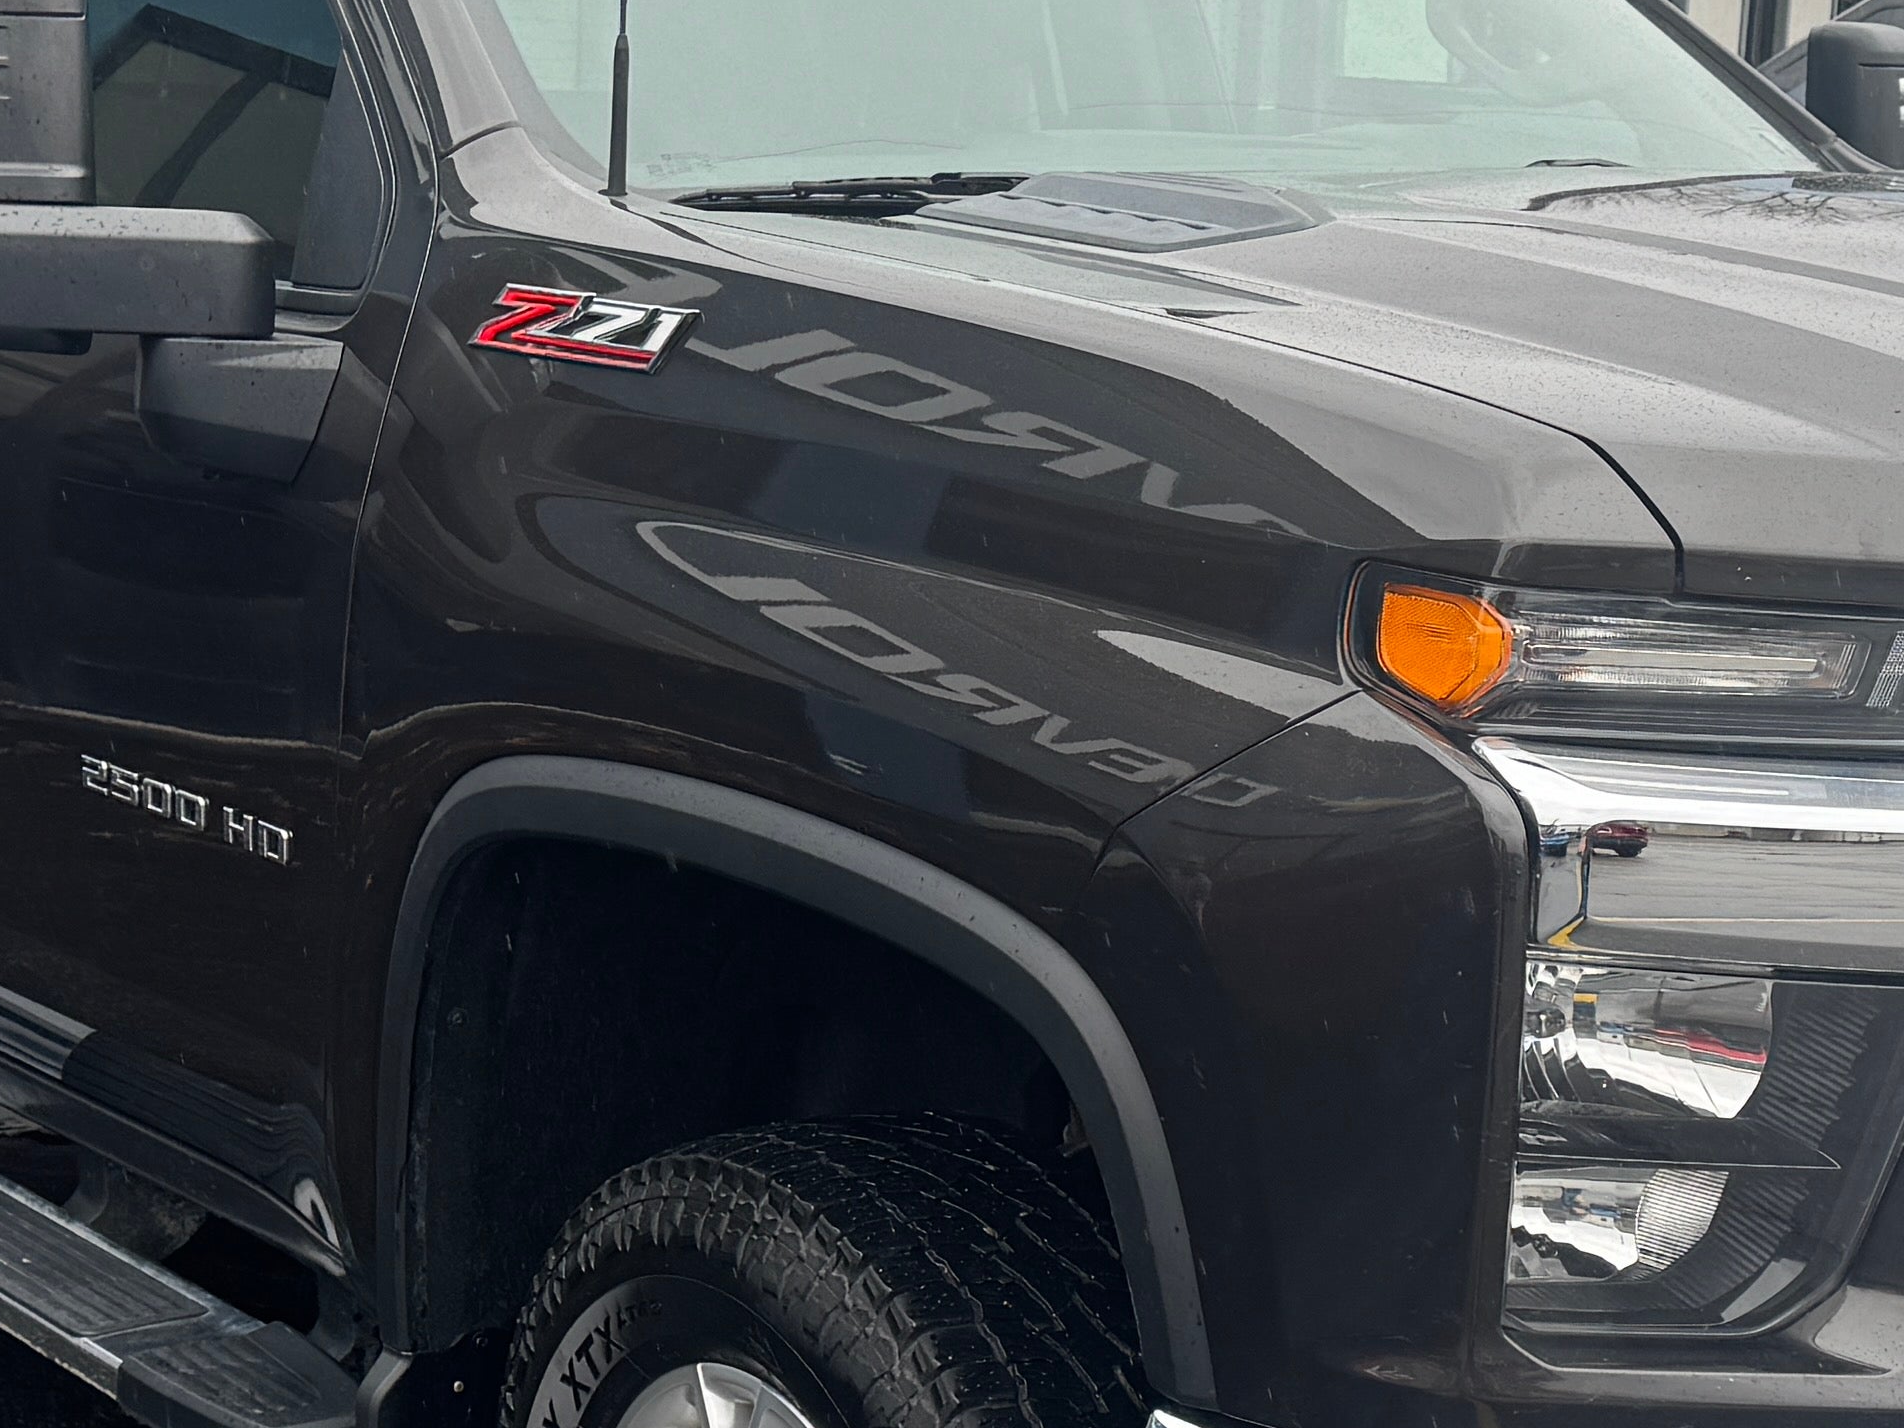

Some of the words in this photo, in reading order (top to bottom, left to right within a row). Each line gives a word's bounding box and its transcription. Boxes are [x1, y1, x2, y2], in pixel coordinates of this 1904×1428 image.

[467, 282, 702, 374] Z71
[81, 753, 209, 832] 2500
[223, 806, 294, 866] HD
[559, 1314, 625, 1411] XTX
